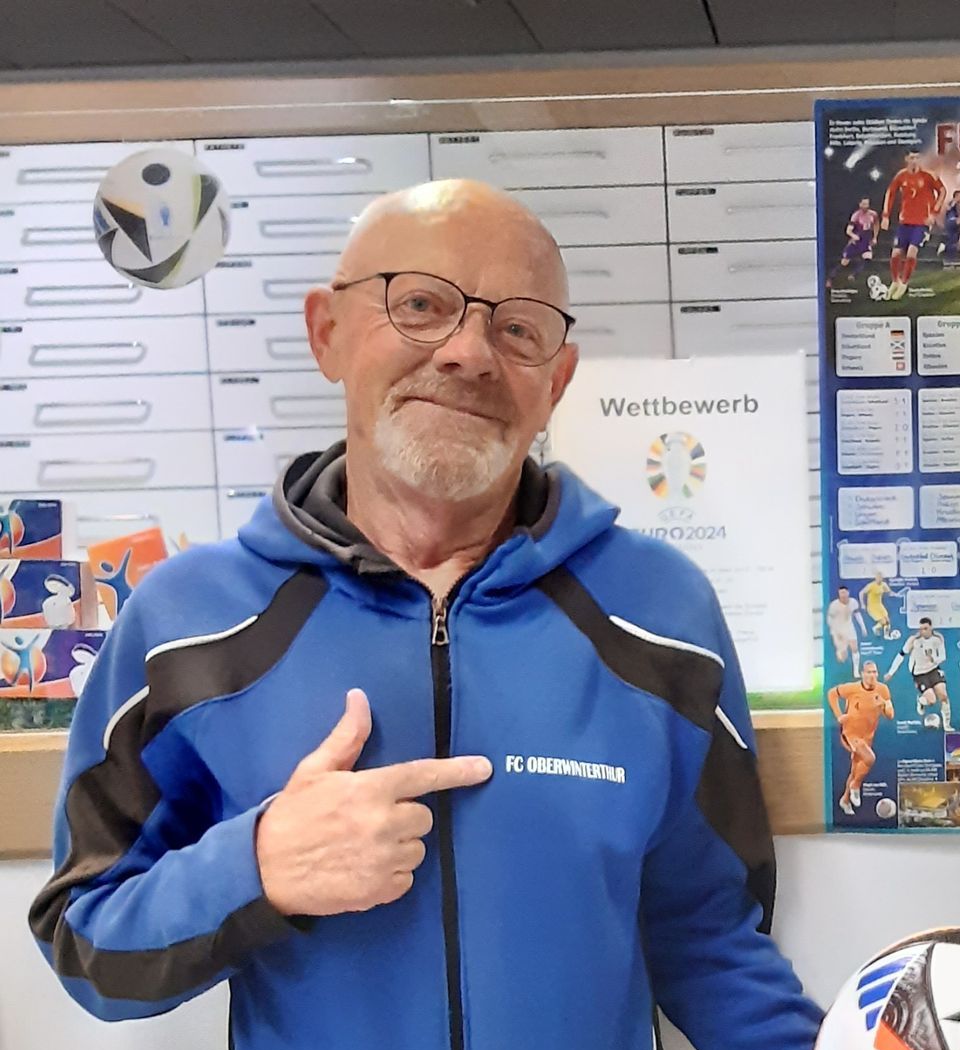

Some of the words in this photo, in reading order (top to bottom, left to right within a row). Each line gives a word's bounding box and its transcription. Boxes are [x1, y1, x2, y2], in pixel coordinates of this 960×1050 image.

[600, 394, 759, 417] Wettbewerb
[505, 755, 524, 773] FC
[526, 756, 626, 784] OBERWINTERTHUR
